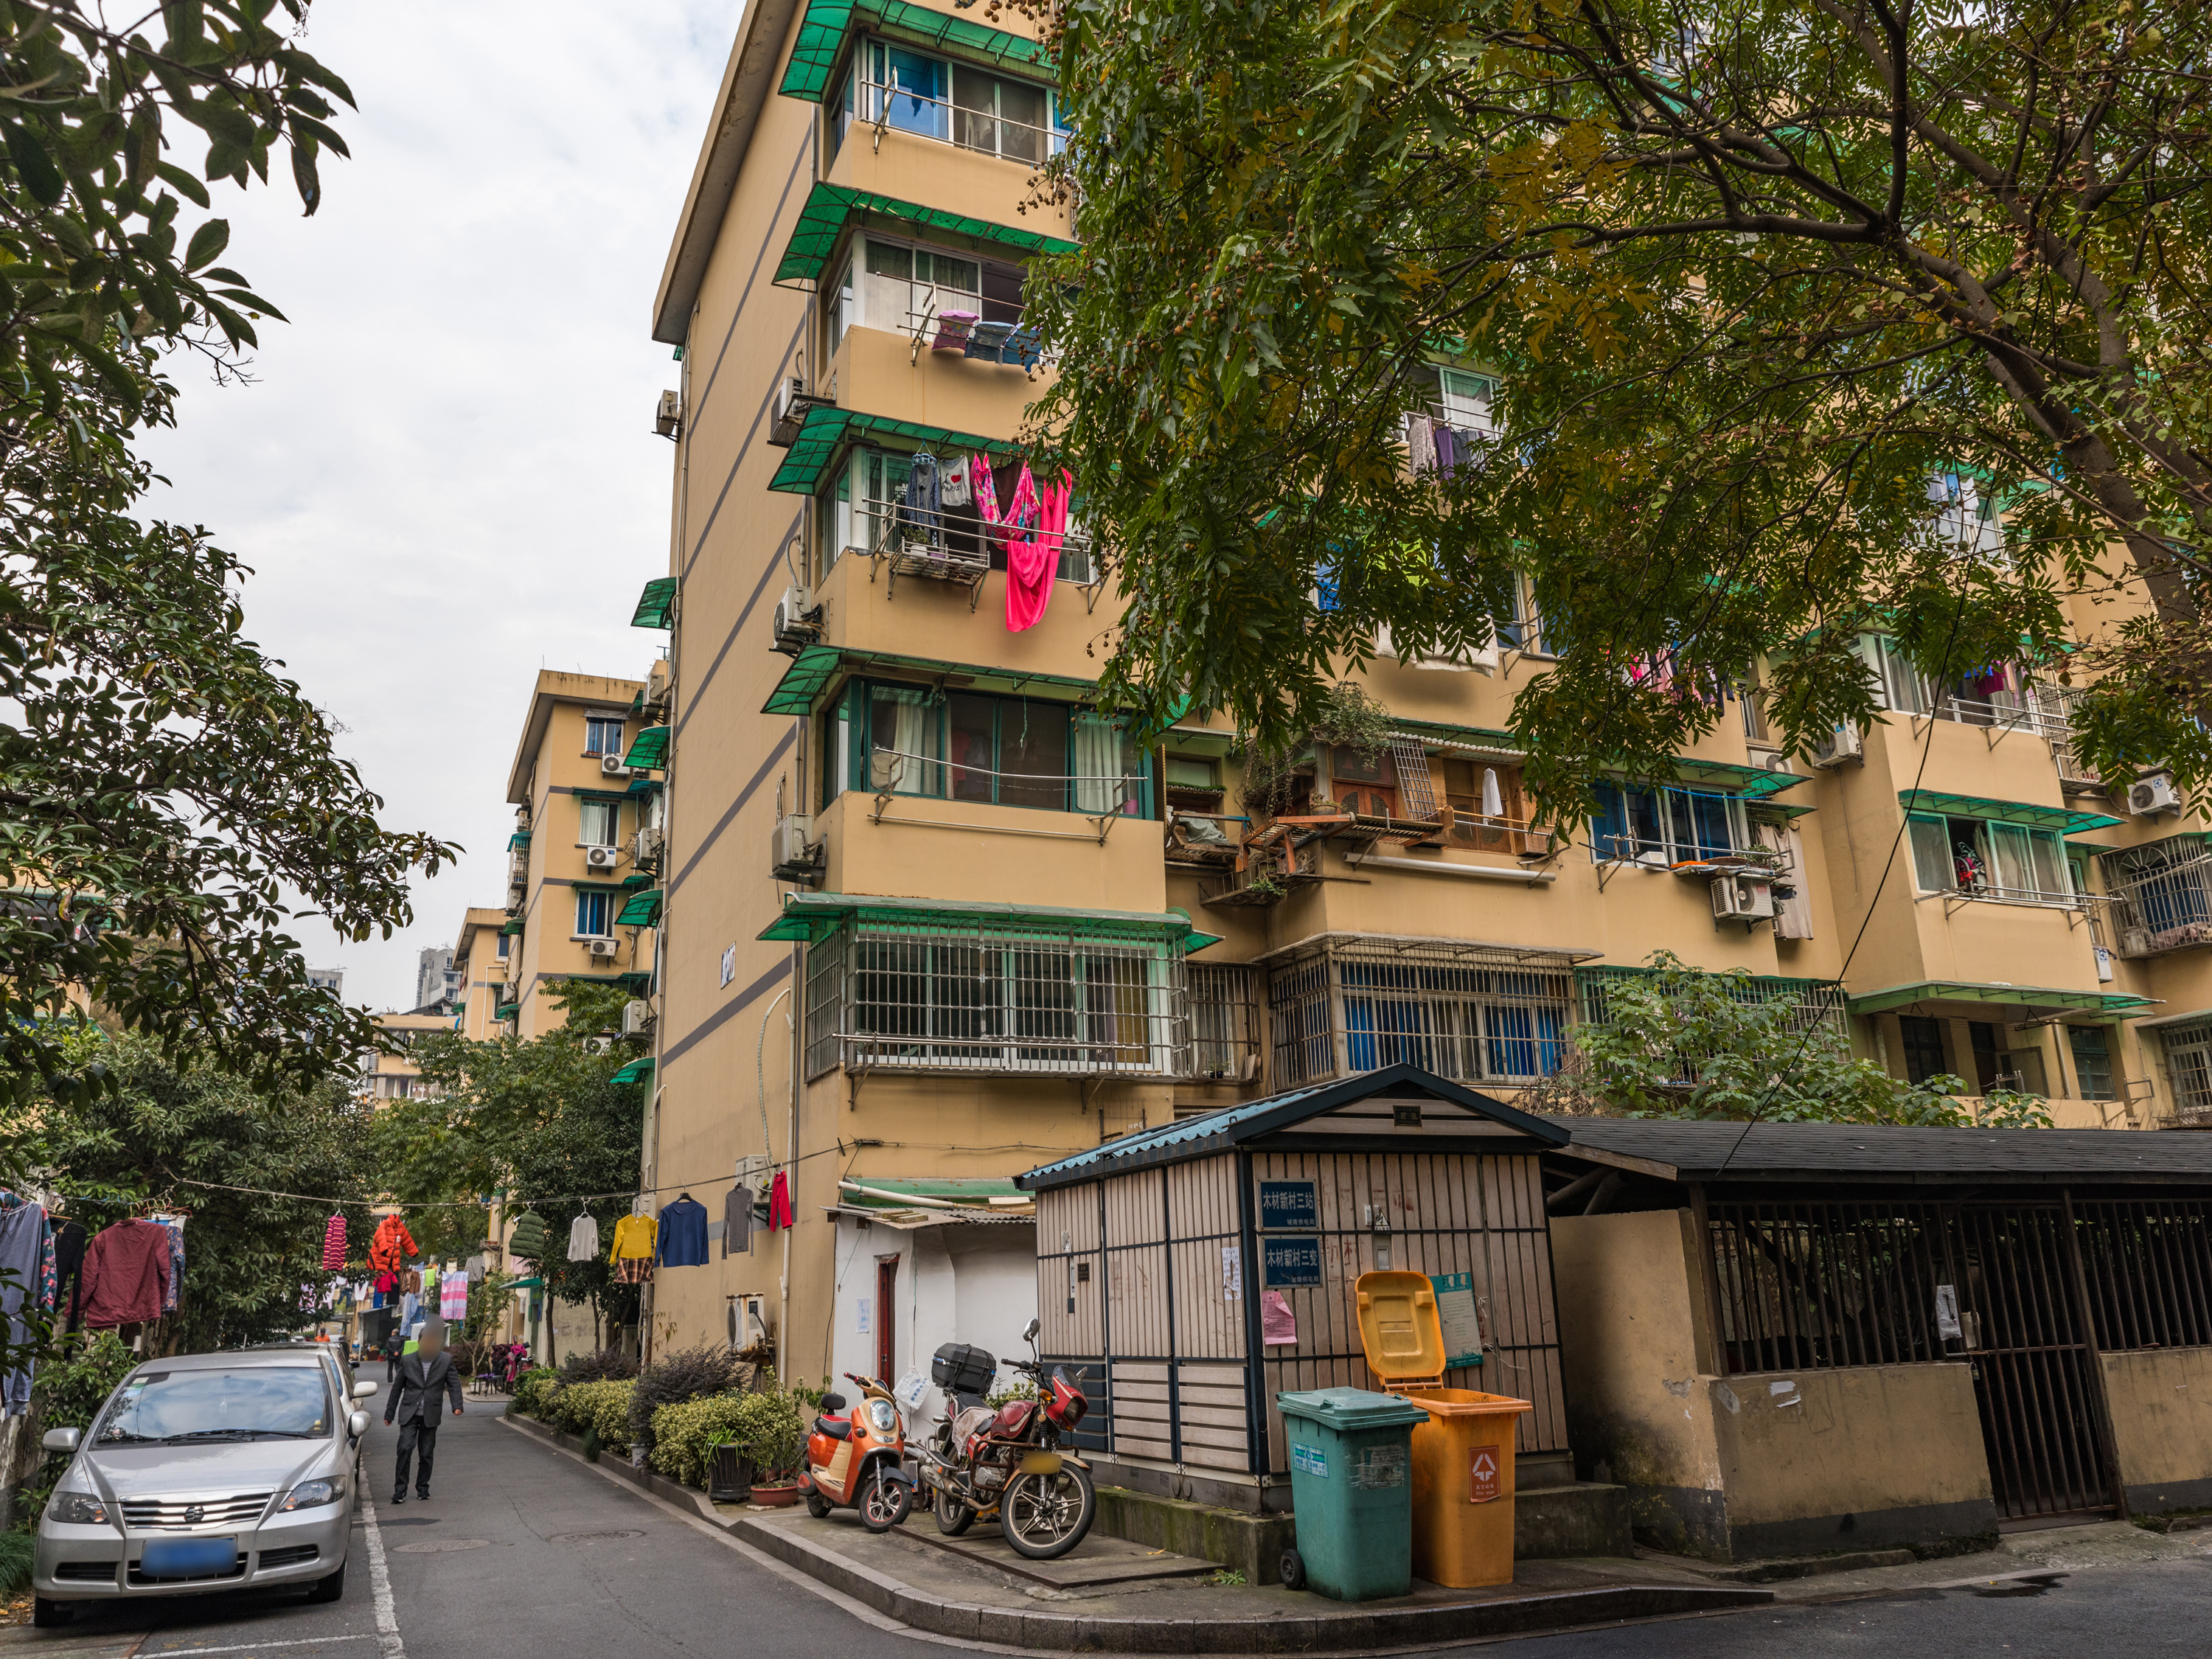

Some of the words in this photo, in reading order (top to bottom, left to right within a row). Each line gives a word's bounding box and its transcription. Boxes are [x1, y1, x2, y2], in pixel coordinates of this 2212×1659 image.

[1263, 1192, 1313, 1209] 木材新村三站
[1267, 1248, 1318, 1267] 木材新村三变
